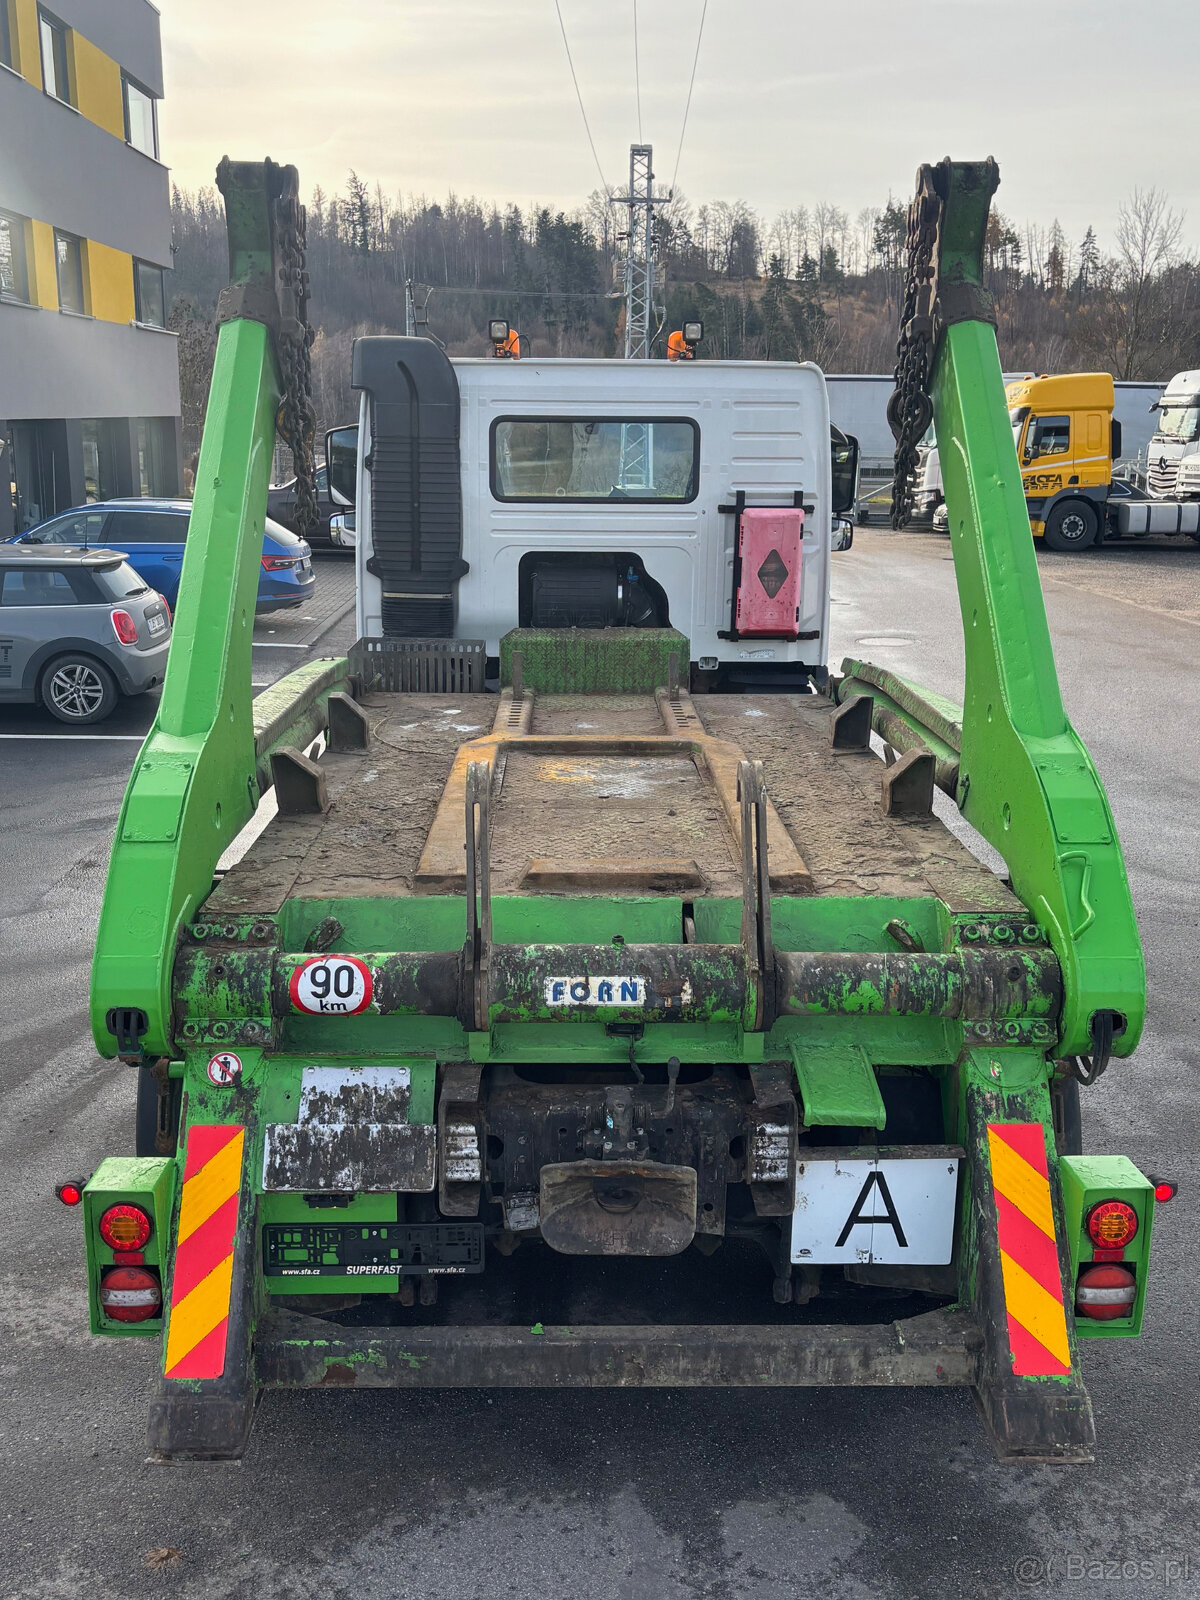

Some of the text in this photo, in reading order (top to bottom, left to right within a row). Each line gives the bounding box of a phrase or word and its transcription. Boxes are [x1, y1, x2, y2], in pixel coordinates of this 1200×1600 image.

[310, 964, 355, 999] 90
[319, 999, 348, 1012] km
[834, 1171, 909, 1248] A
[281, 1265, 466, 1276] www.sfa.cz SUPERFAST www.sfa.cz
